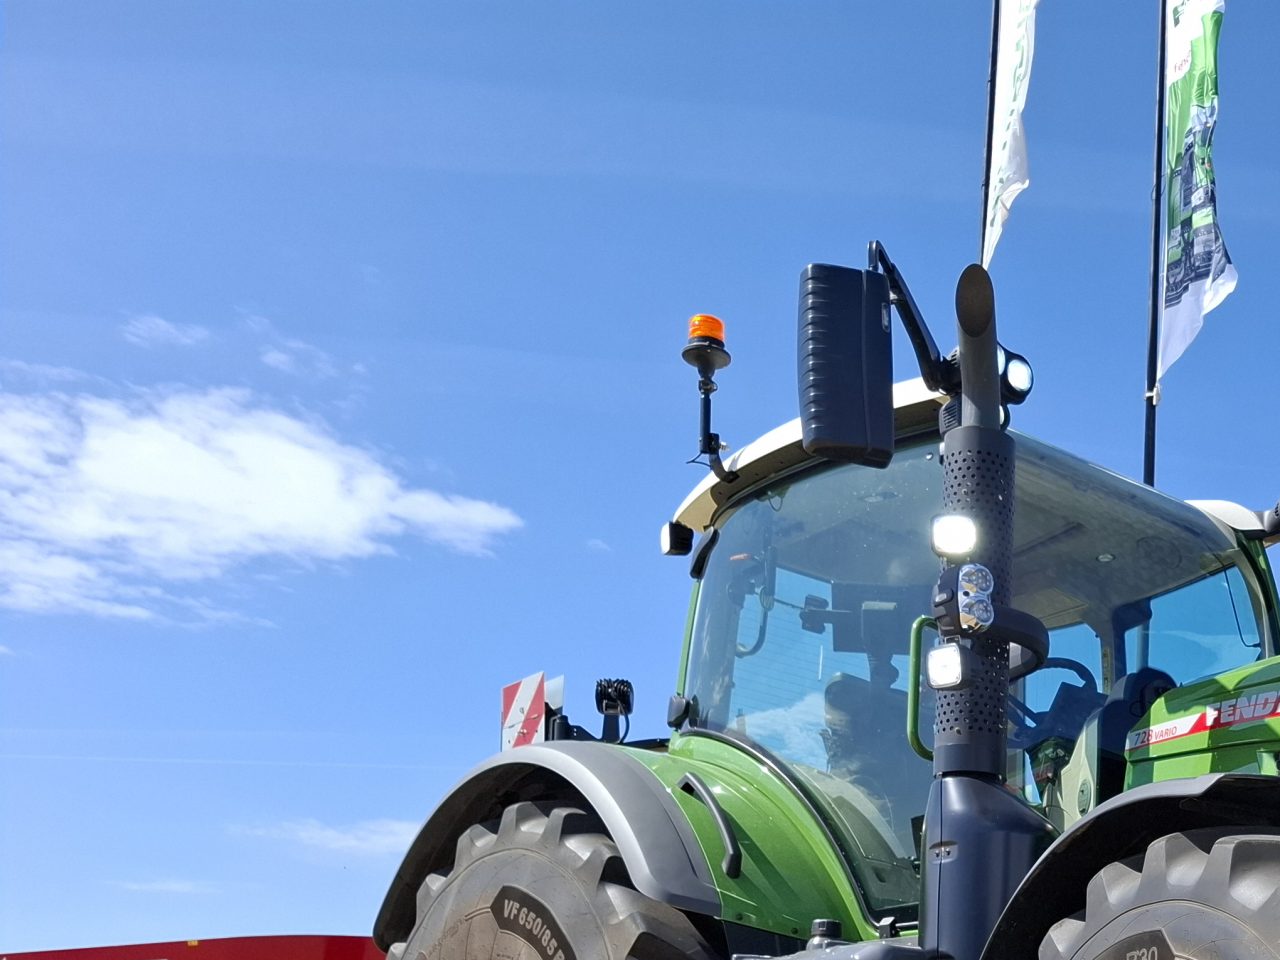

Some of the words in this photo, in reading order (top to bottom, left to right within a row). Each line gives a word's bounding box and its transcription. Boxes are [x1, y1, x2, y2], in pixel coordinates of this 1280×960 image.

[1134, 729, 1153, 747] 728
[1155, 726, 1177, 740] VARIO
[503, 899, 519, 920] VF
[519, 907, 558, 956] 650/85
